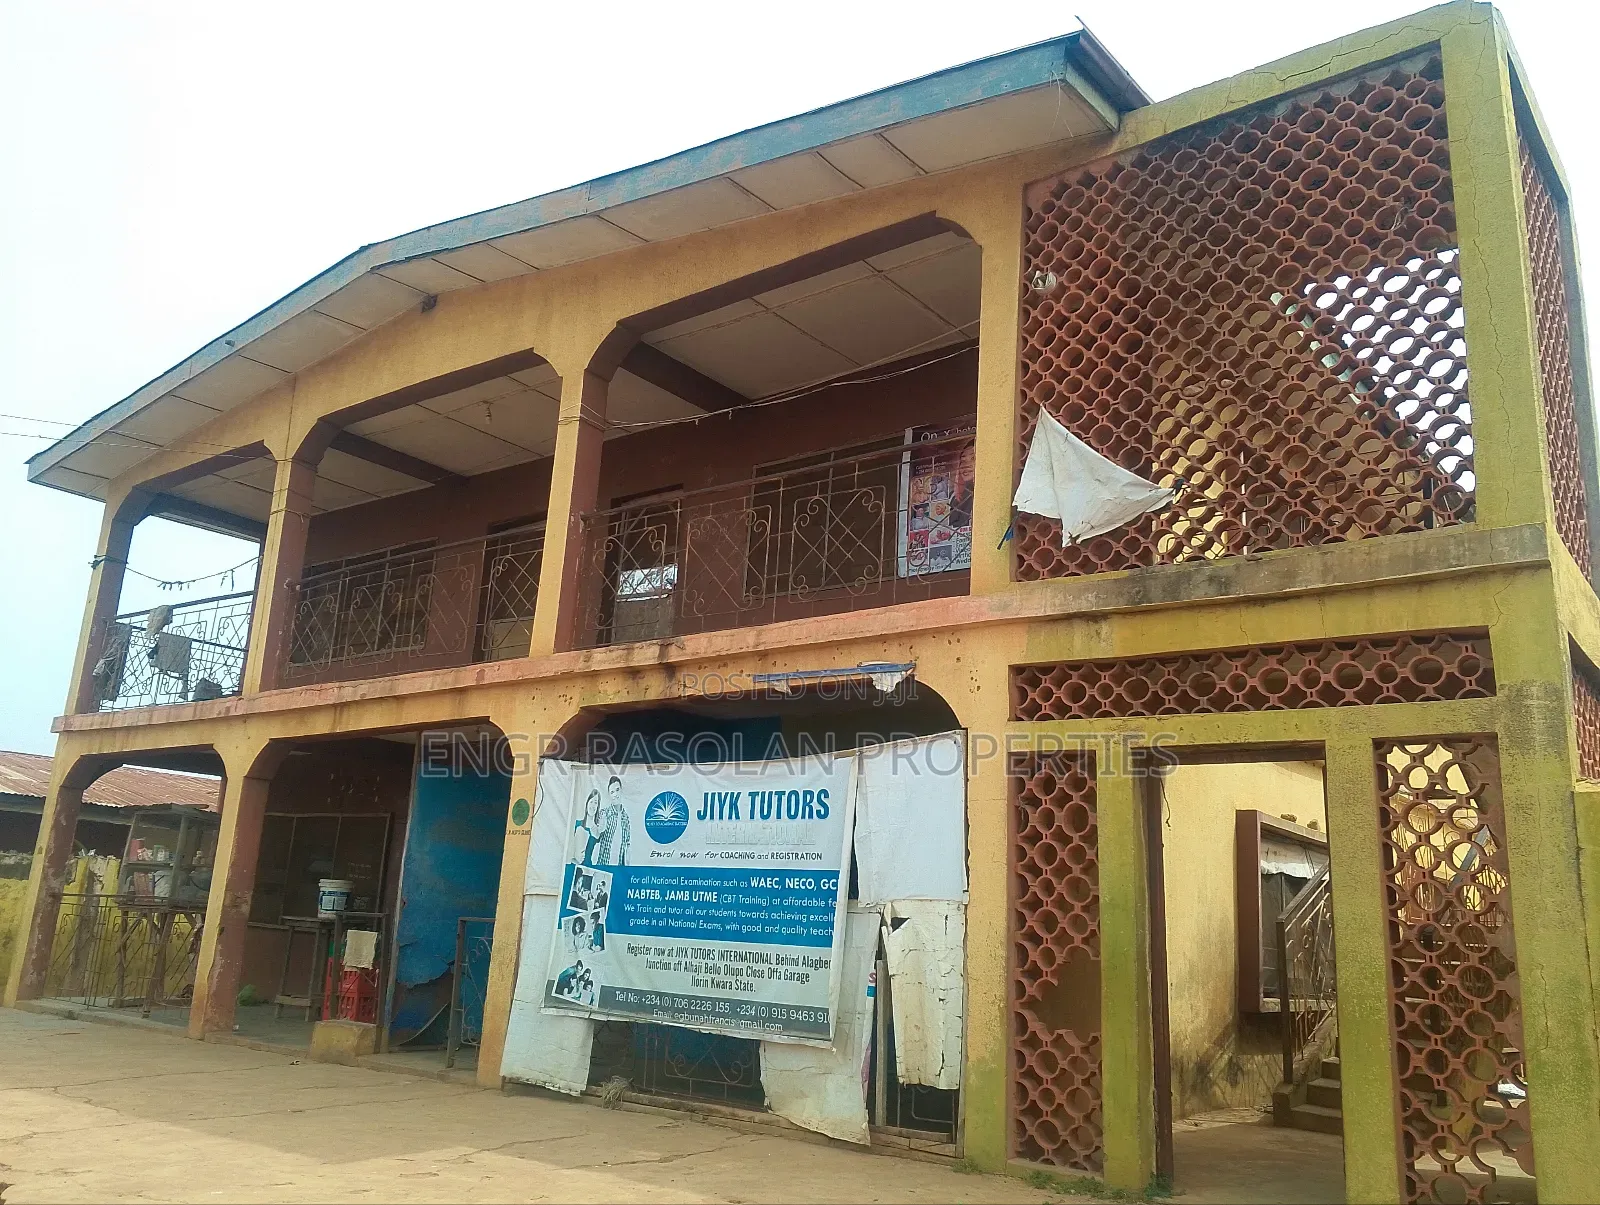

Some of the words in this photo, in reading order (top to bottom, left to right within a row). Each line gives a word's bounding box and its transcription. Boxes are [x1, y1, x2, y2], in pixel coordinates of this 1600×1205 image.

[697, 791, 741, 820] JIYK
[749, 789, 830, 820] TUTORS
[650, 850, 675, 858] Enrol
[680, 851, 698, 859] now
[705, 850, 718, 859] for
[720, 851, 755, 860] COACHING
[757, 852, 769, 860] and
[771, 852, 823, 861] REGISTRATION
[630, 874, 640, 884] for
[641, 875, 650, 884] all
[651, 876, 679, 885] National
[680, 876, 721, 887] Examination
[723, 878, 738, 887] such
[740, 880, 748, 888] as
[750, 876, 782, 890] WAEC,
[785, 877, 817, 892] NECO,
[627, 888, 662, 902] NABTEB,
[664, 890, 690, 901] JAMB
[692, 891, 718, 902] UTME
[719, 893, 736, 905] (CBT
[739, 894, 769, 907] Training)
[772, 897, 780, 905] at
[783, 896, 826, 907] affordable
[624, 903, 635, 912] We
[654, 904, 667, 914] and
[668, 906, 683, 915] tutor
[685, 906, 694, 915] all
[695, 908, 707, 916] our
[708, 907, 737, 918] students
[739, 909, 769, 919] towards
[771, 910, 807, 923] achieving
[629, 917, 650, 927] grade
[651, 917, 657, 926] in
[658, 918, 667, 926] all
[668, 918, 698, 929] National
[699, 919, 723, 932] Exams,
[725, 921, 740, 931] with
[741, 922, 762, 934] good
[764, 923, 780, 933] and
[781, 925, 808, 937] quality
[627, 943, 652, 957] Register
[653, 947, 666, 957] now
[667, 946, 675, 958] at
[690, 947, 716, 961] TUTORS
[717, 949, 774, 965] INTERNATIONAL
[775, 953, 800, 967] Behind
[645, 957, 672, 971] Junction
[673, 960, 683, 972] off
[684, 961, 703, 976] Alhaji
[704, 962, 722, 976] Bello
[723, 963, 744, 979] Olupo
[746, 965, 765, 979] Close
[767, 966, 782, 981] Offa
[783, 968, 811, 985] Garage
[710, 976, 733, 990] Kwara
[734, 978, 756, 993] State.
[615, 991, 626, 1001] Tel
[628, 992, 640, 1004] No:
[641, 994, 660, 1006] +234
[661, 995, 672, 1007] (0)
[673, 997, 689, 1009] 706
[690, 999, 712, 1012] 2226
[714, 1001, 732, 1015] 155,
[736, 1004, 756, 1016] +234
[757, 1006, 769, 1018] (0)
[771, 1007, 787, 1019] 915
[789, 1009, 815, 1022] 9463
